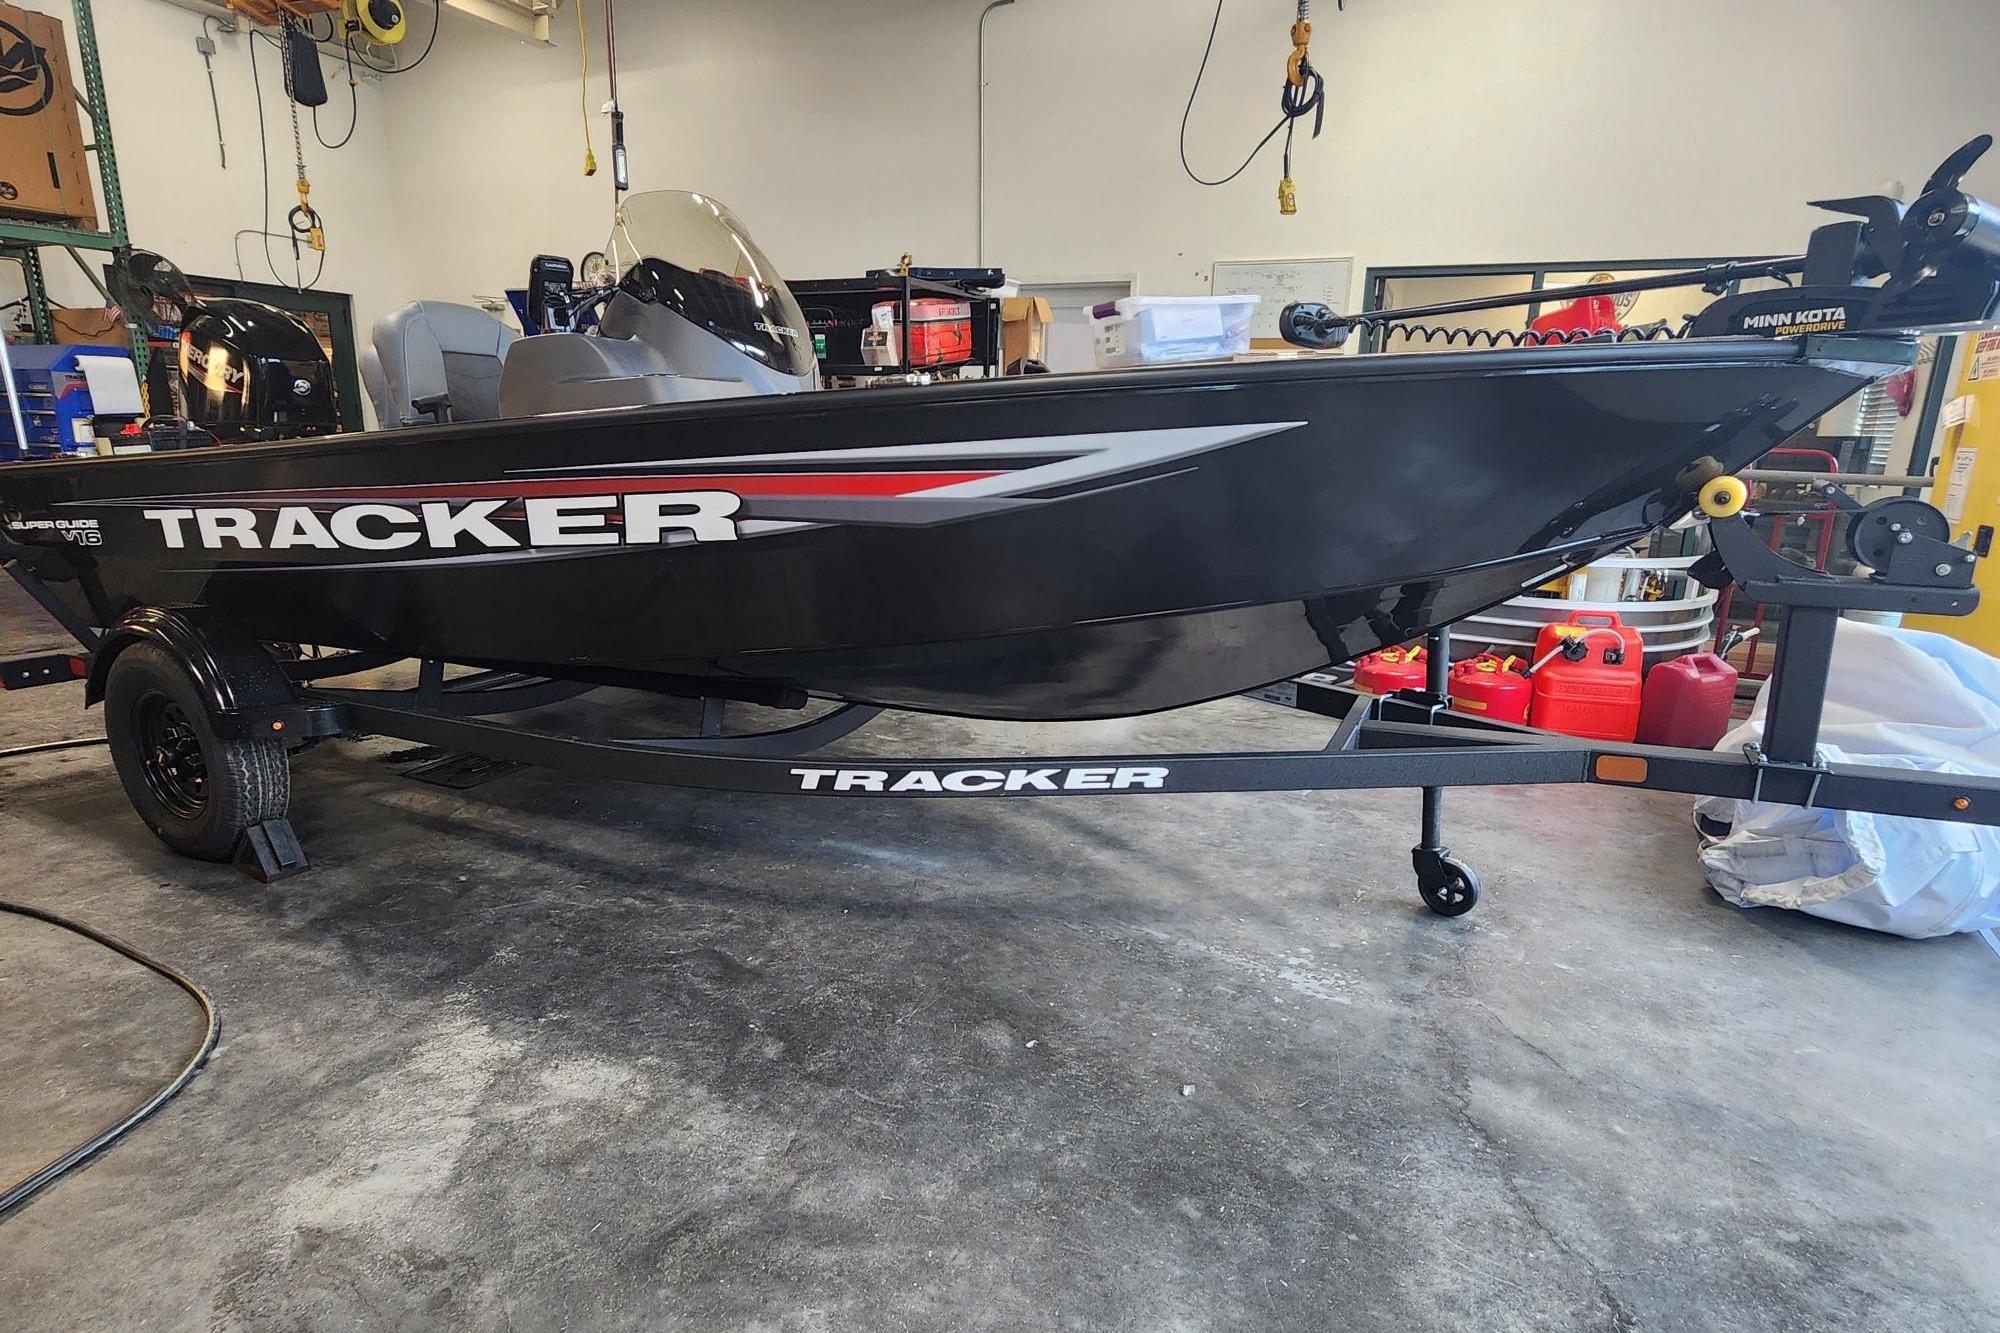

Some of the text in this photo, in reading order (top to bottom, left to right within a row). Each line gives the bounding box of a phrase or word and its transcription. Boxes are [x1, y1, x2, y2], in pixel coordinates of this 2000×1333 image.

[1743, 306, 1846, 329] MINN KOTA
[754, 322, 799, 338] TRACKER
[1775, 320, 1846, 335] POWERDRIVE
[11, 519, 99, 529] SUPER GUIDE
[143, 489, 742, 551] TRACKER
[61, 529, 103, 546] V16
[790, 767, 1170, 793] TRACKER
